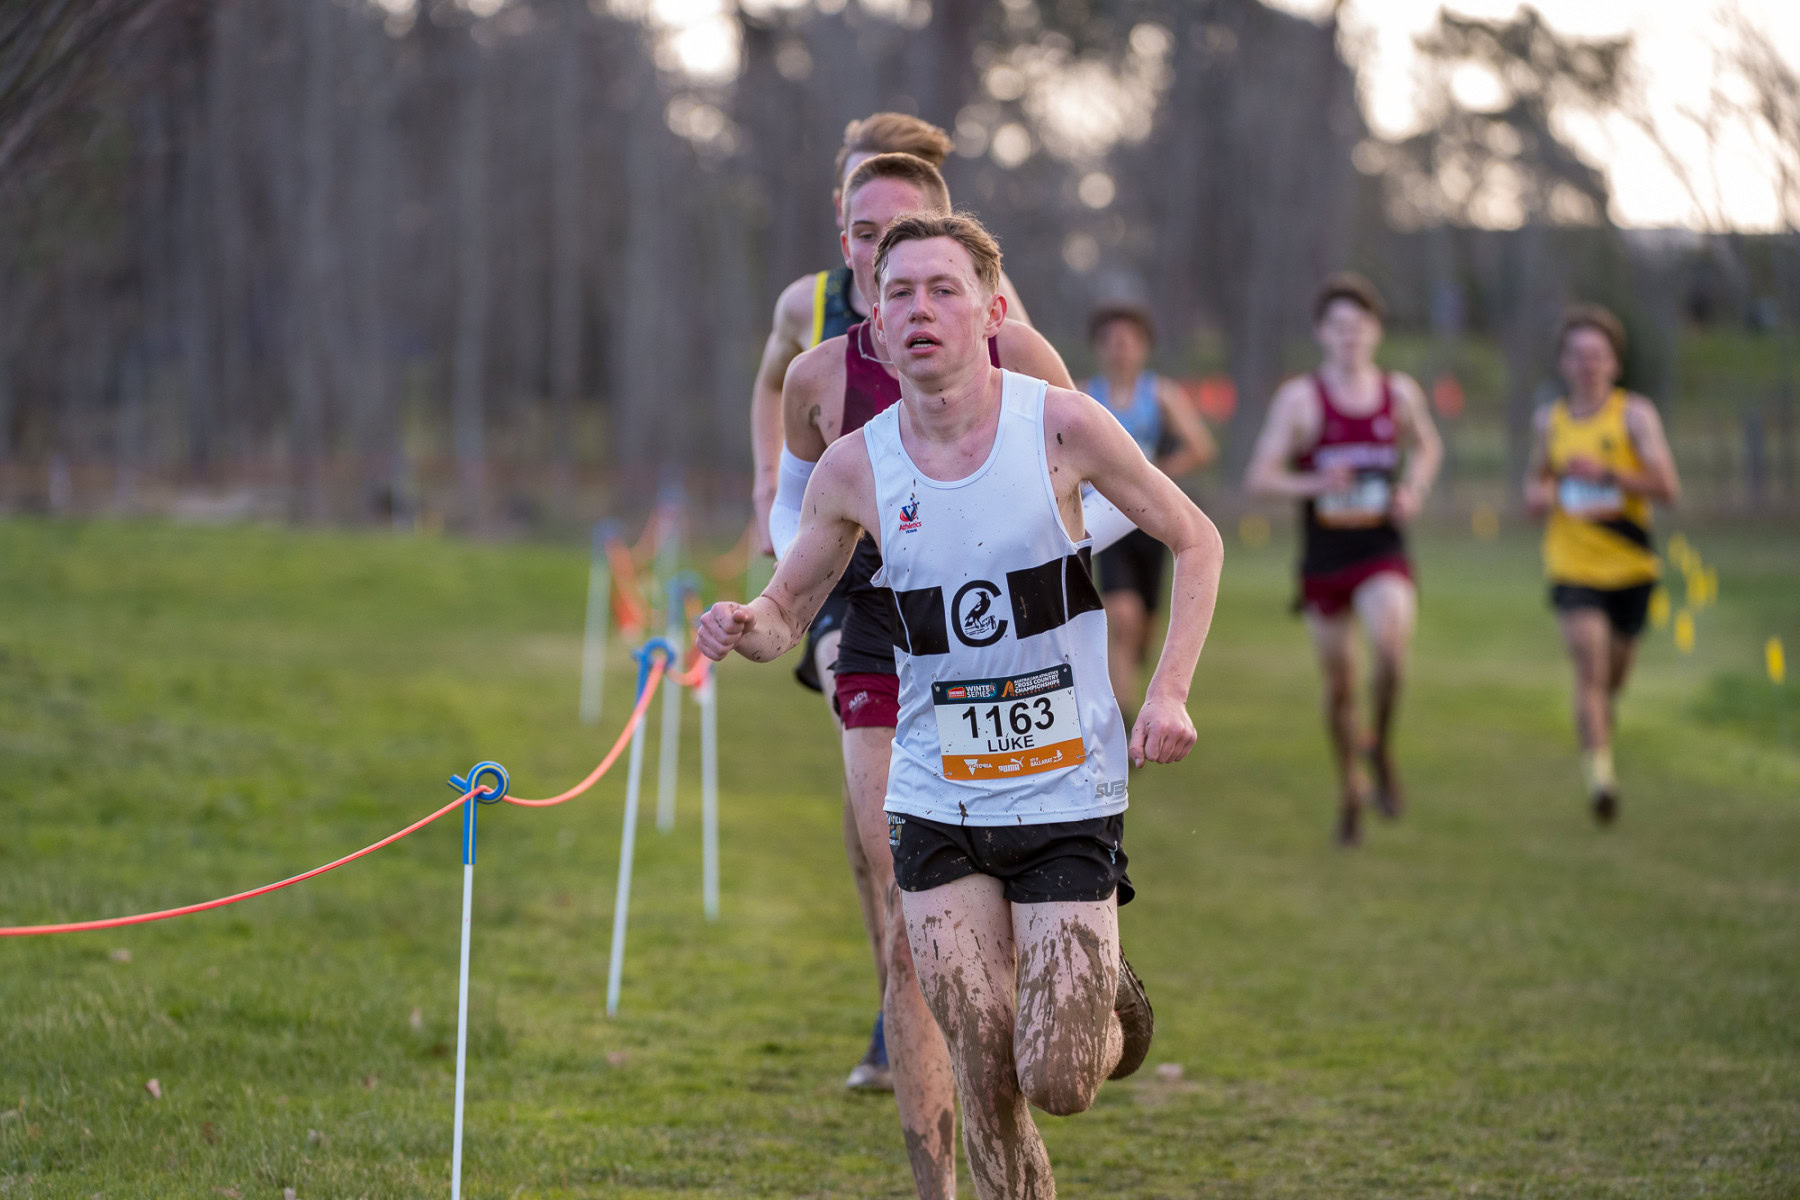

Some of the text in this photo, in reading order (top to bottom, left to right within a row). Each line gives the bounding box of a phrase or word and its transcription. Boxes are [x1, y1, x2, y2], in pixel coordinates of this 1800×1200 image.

[898, 521, 922, 532] Athletics
[951, 580, 1009, 648] C
[1014, 674, 1059, 689] CROSS COUNTRY
[1014, 678, 1060, 694] CHAMPIONSHIPS
[966, 690, 991, 698] SERIES
[962, 697, 1055, 738] 1163
[987, 735, 1035, 752] LUKE
[998, 763, 1020, 773] PUMA
[1030, 757, 1053, 767] BALLARAT
